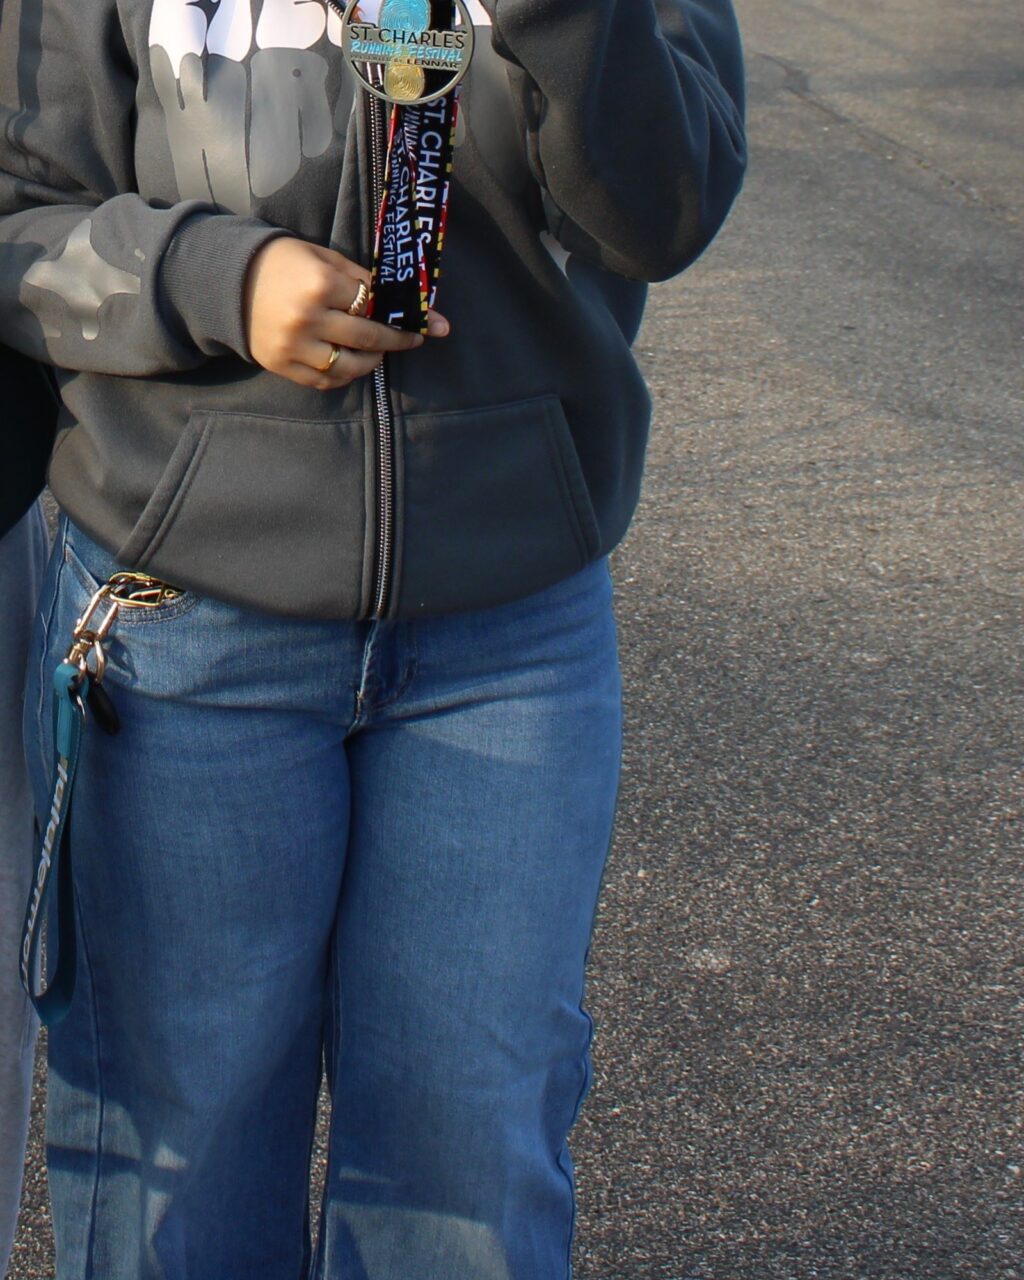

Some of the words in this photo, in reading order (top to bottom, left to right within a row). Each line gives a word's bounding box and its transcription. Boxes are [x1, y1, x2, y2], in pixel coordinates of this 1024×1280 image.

[350, 26, 373, 42] ST.
[378, 28, 465, 49] CHARLES
[351, 41, 403, 57] RUNNING
[407, 45, 462, 62] FESTIVAL
[407, 58, 458, 68] LENNAR
[424, 96, 447, 124] ST.
[416, 131, 442, 244] CHARLES
[396, 166, 414, 282] CHARLES
[380, 211, 396, 285] FESTIVAL
